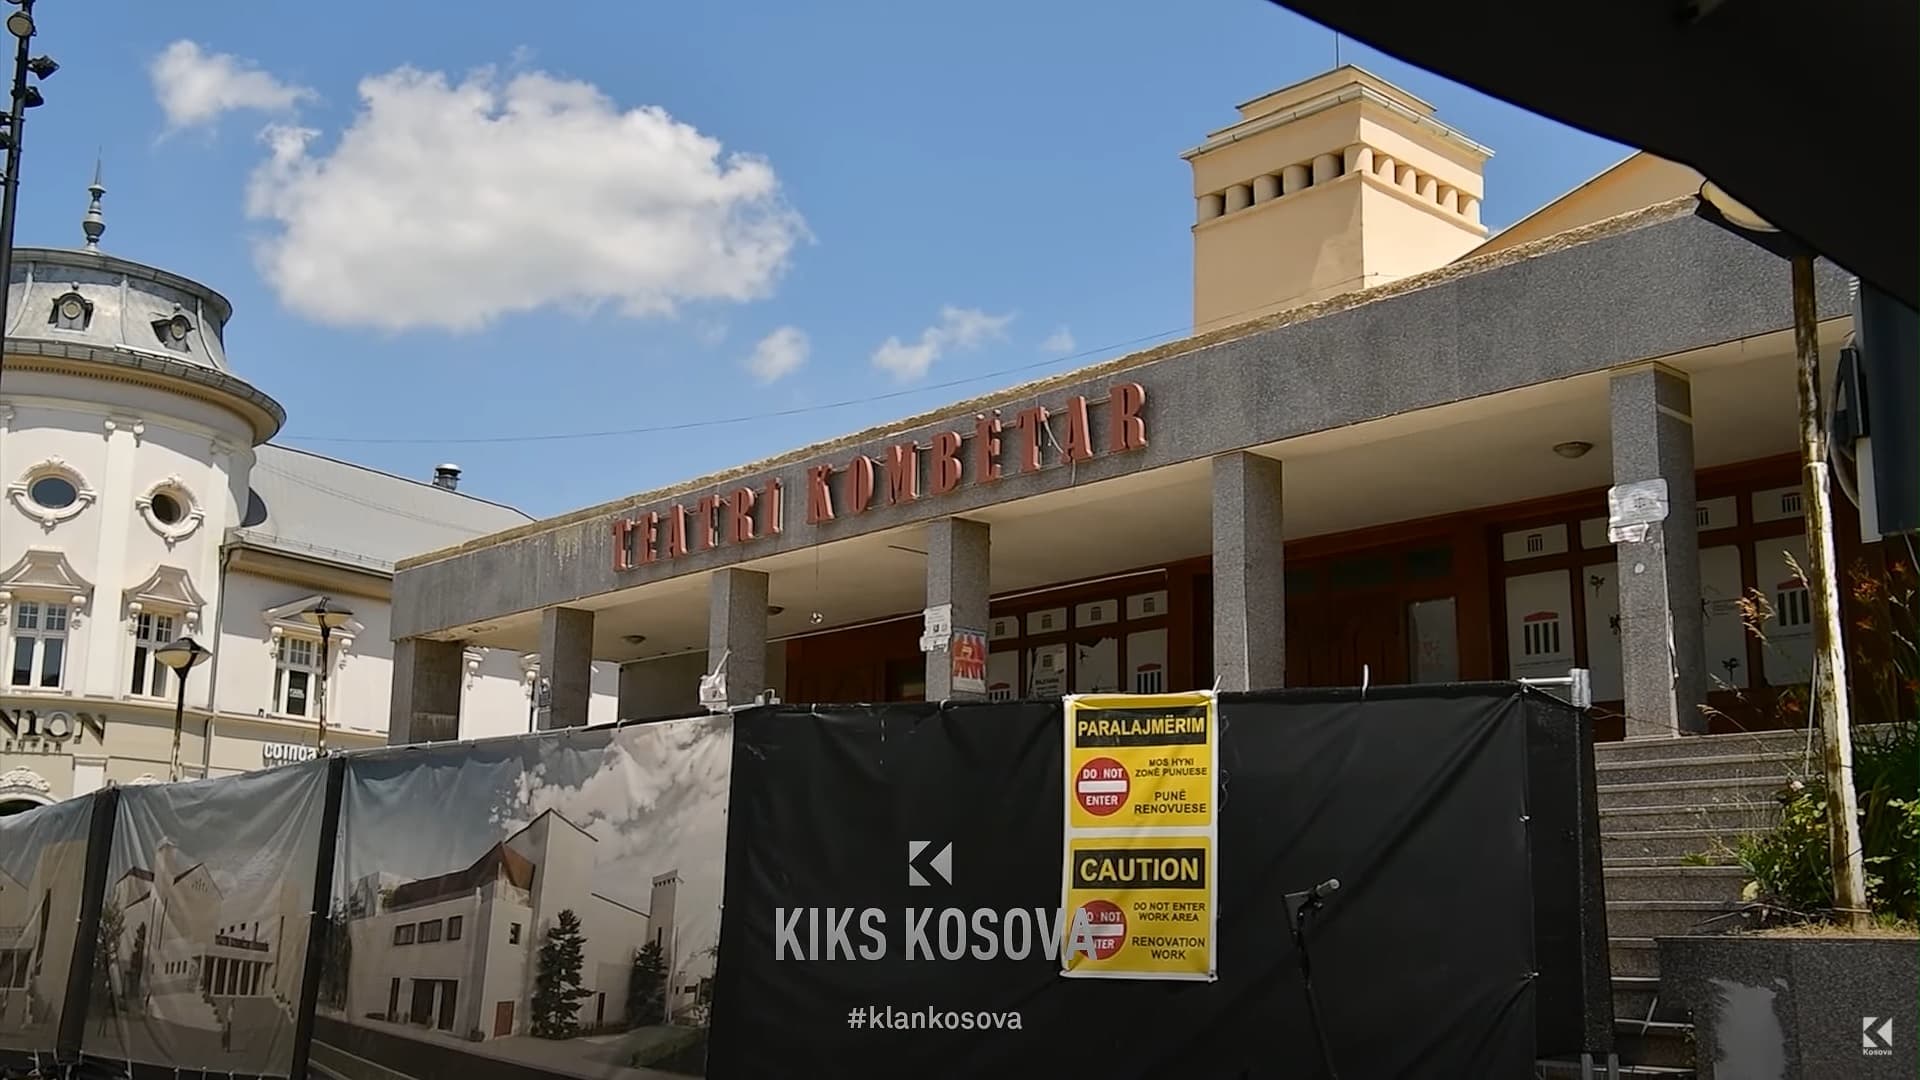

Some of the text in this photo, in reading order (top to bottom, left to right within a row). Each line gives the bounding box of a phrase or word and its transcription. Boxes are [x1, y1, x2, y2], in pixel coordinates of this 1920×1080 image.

[611, 382, 1148, 572] TEATRI KOMBËTAR
[1078, 714, 1205, 737] PARALAJMËRIM
[1149, 758, 1194, 767] MOS HYNI
[1083, 768, 1123, 779] DO NOT
[1162, 767, 1207, 776] PUNUESE
[1086, 795, 1118, 806] ENTER
[1134, 803, 1207, 814] RENOVUESE
[1080, 857, 1199, 882] CAUTION
[1133, 902, 1206, 911] DO NOT ENTER
[1101, 911, 1121, 922] NOT
[1139, 912, 1199, 922] WORK AREA
[1132, 936, 1206, 948] RENOVATION
[1151, 949, 1186, 960] WORK
